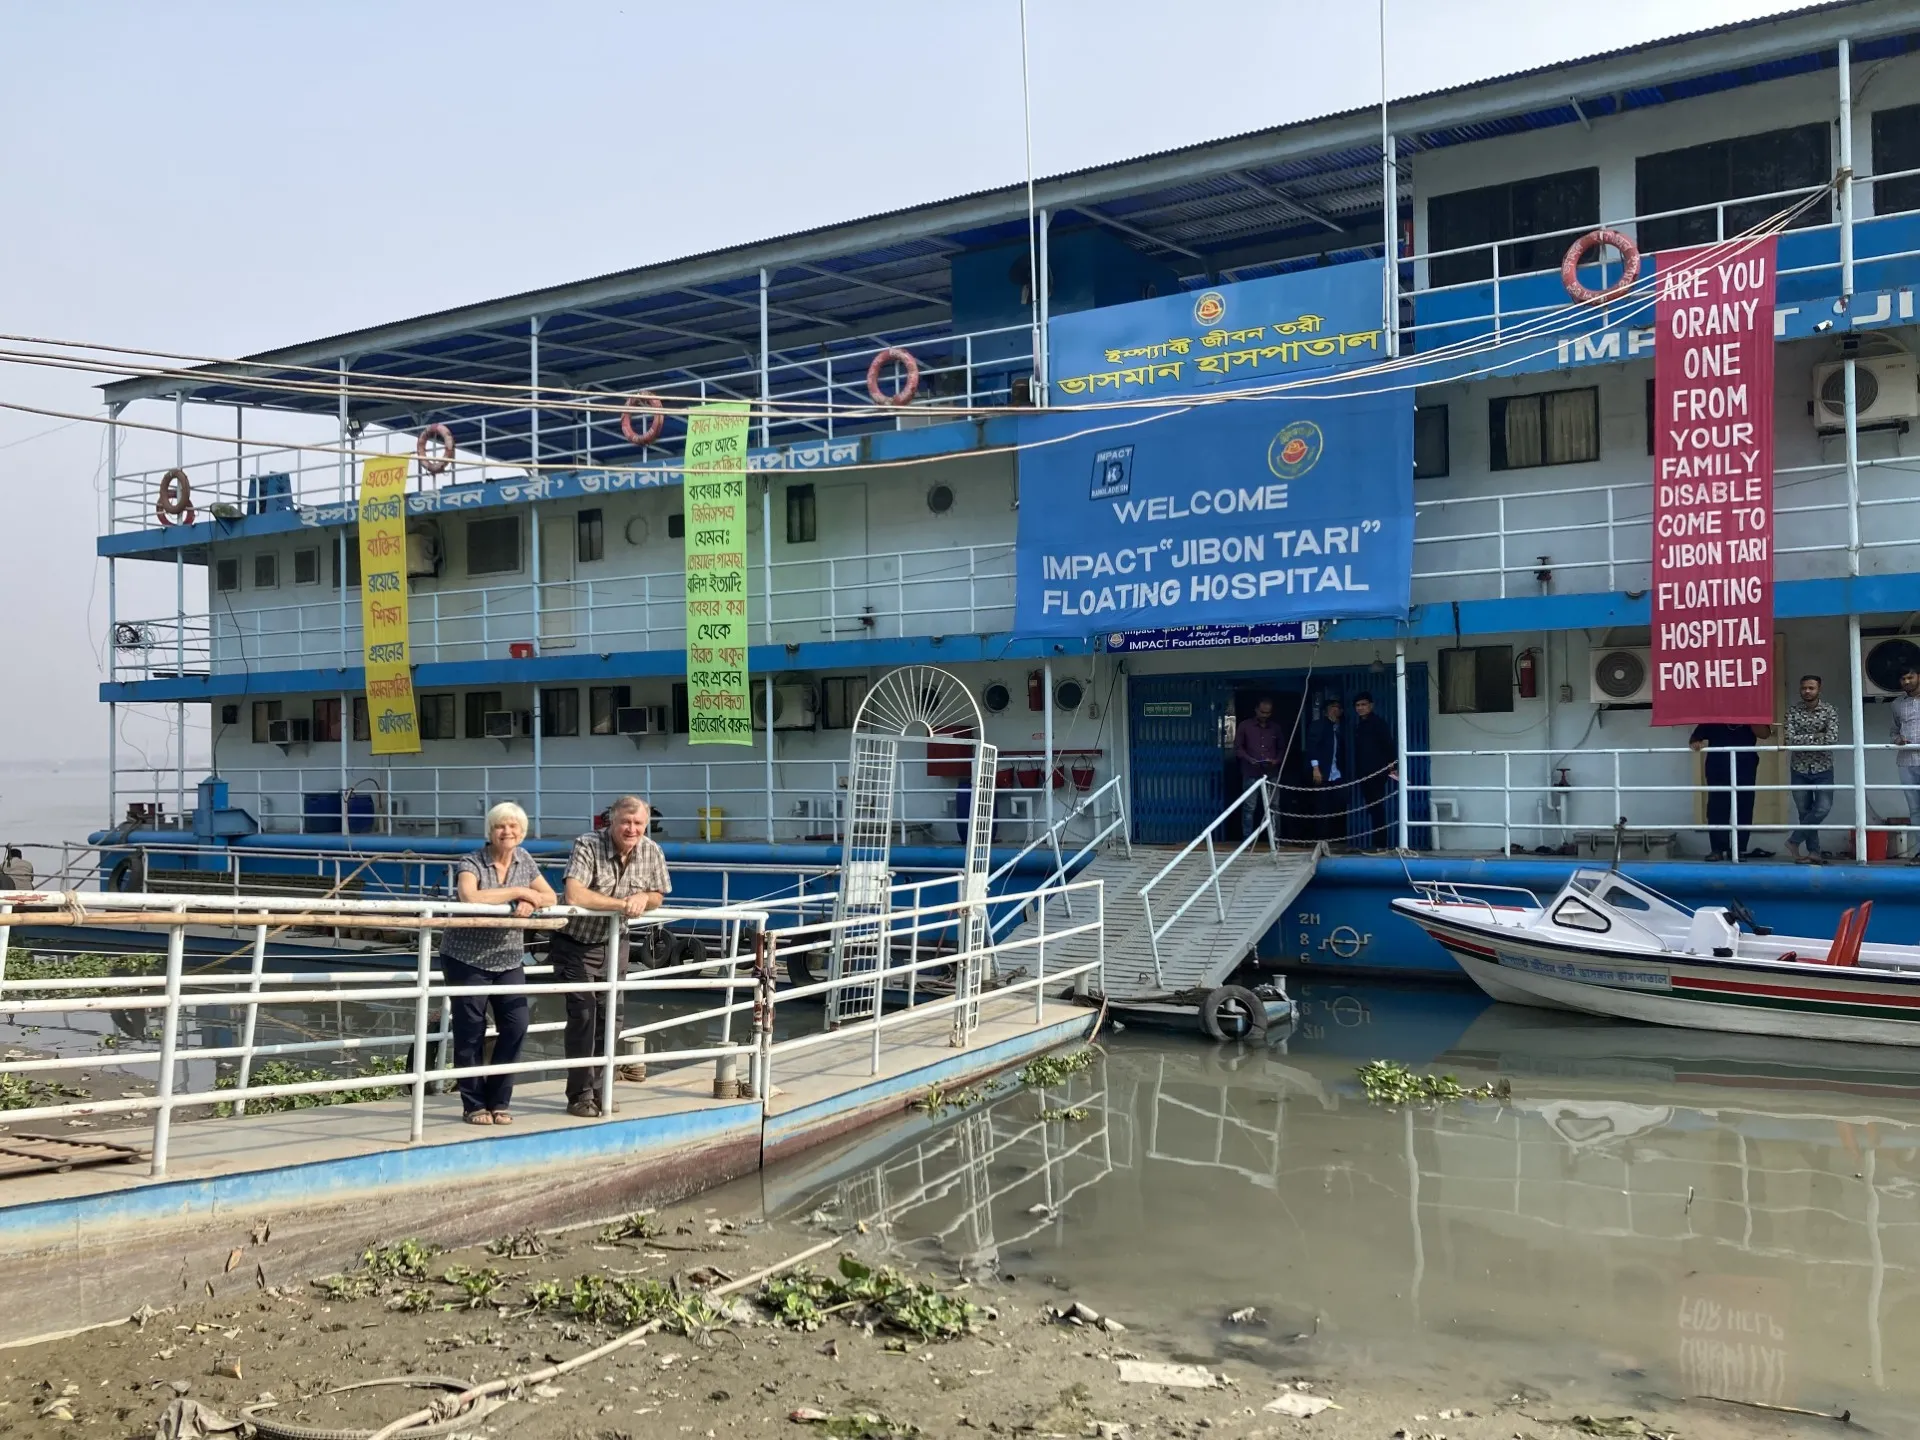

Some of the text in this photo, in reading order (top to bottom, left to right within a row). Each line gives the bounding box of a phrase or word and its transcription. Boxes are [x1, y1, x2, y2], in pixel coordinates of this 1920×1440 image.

[1663, 258, 1765, 301] ARE YOU
[1672, 298, 1759, 339] ORANY
[1104, 314, 1325, 364] ইম্প্যাক্ট জীবন তরী
[1557, 307, 1800, 364] IMPT
[1057, 329, 1384, 394] ভাসমান হাসপাতাল
[1684, 342, 1741, 379] ONE
[1673, 384, 1748, 422] FROM
[692, 435, 739, 457] রোগ আছে
[1670, 422, 1754, 451] YOUR
[1097, 448, 1133, 463] IMPACT
[1662, 449, 1760, 480] FAMILY
[366, 466, 405, 488] প্রত্যেক
[688, 481, 743, 500] ব্যবহার করা
[408, 488, 485, 513] জীবন
[1113, 484, 1289, 524] WELCOME
[1660, 478, 1762, 507] DISABLE
[691, 502, 736, 524] জিনিসপত্র
[1658, 507, 1765, 537] COME TO
[366, 529, 402, 557] ব্যক্তির
[1042, 545, 1159, 580] IMPACT
[367, 571, 400, 593] রয়েছে
[709, 571, 741, 592] ইত্যাদি
[1042, 565, 1369, 616] FLOATING HOSPITAL
[1658, 576, 1762, 611] FLOATING
[370, 600, 402, 628] শিক্ষা
[689, 600, 745, 617] ব্যবহার করা
[698, 624, 731, 640] থেকে
[1129, 632, 1296, 650] IMPACT Foundation Bangladesh
[1661, 617, 1766, 650] HOSPITAL
[368, 642, 404, 663] গ্রহনের
[691, 643, 745, 668] বিরত থাকুন
[1659, 657, 1767, 691] FOR HELP
[691, 712, 727, 733] প্রতিরোধ
[1299, 913, 1320, 925] 2M
[1300, 933, 1310, 945] 8
